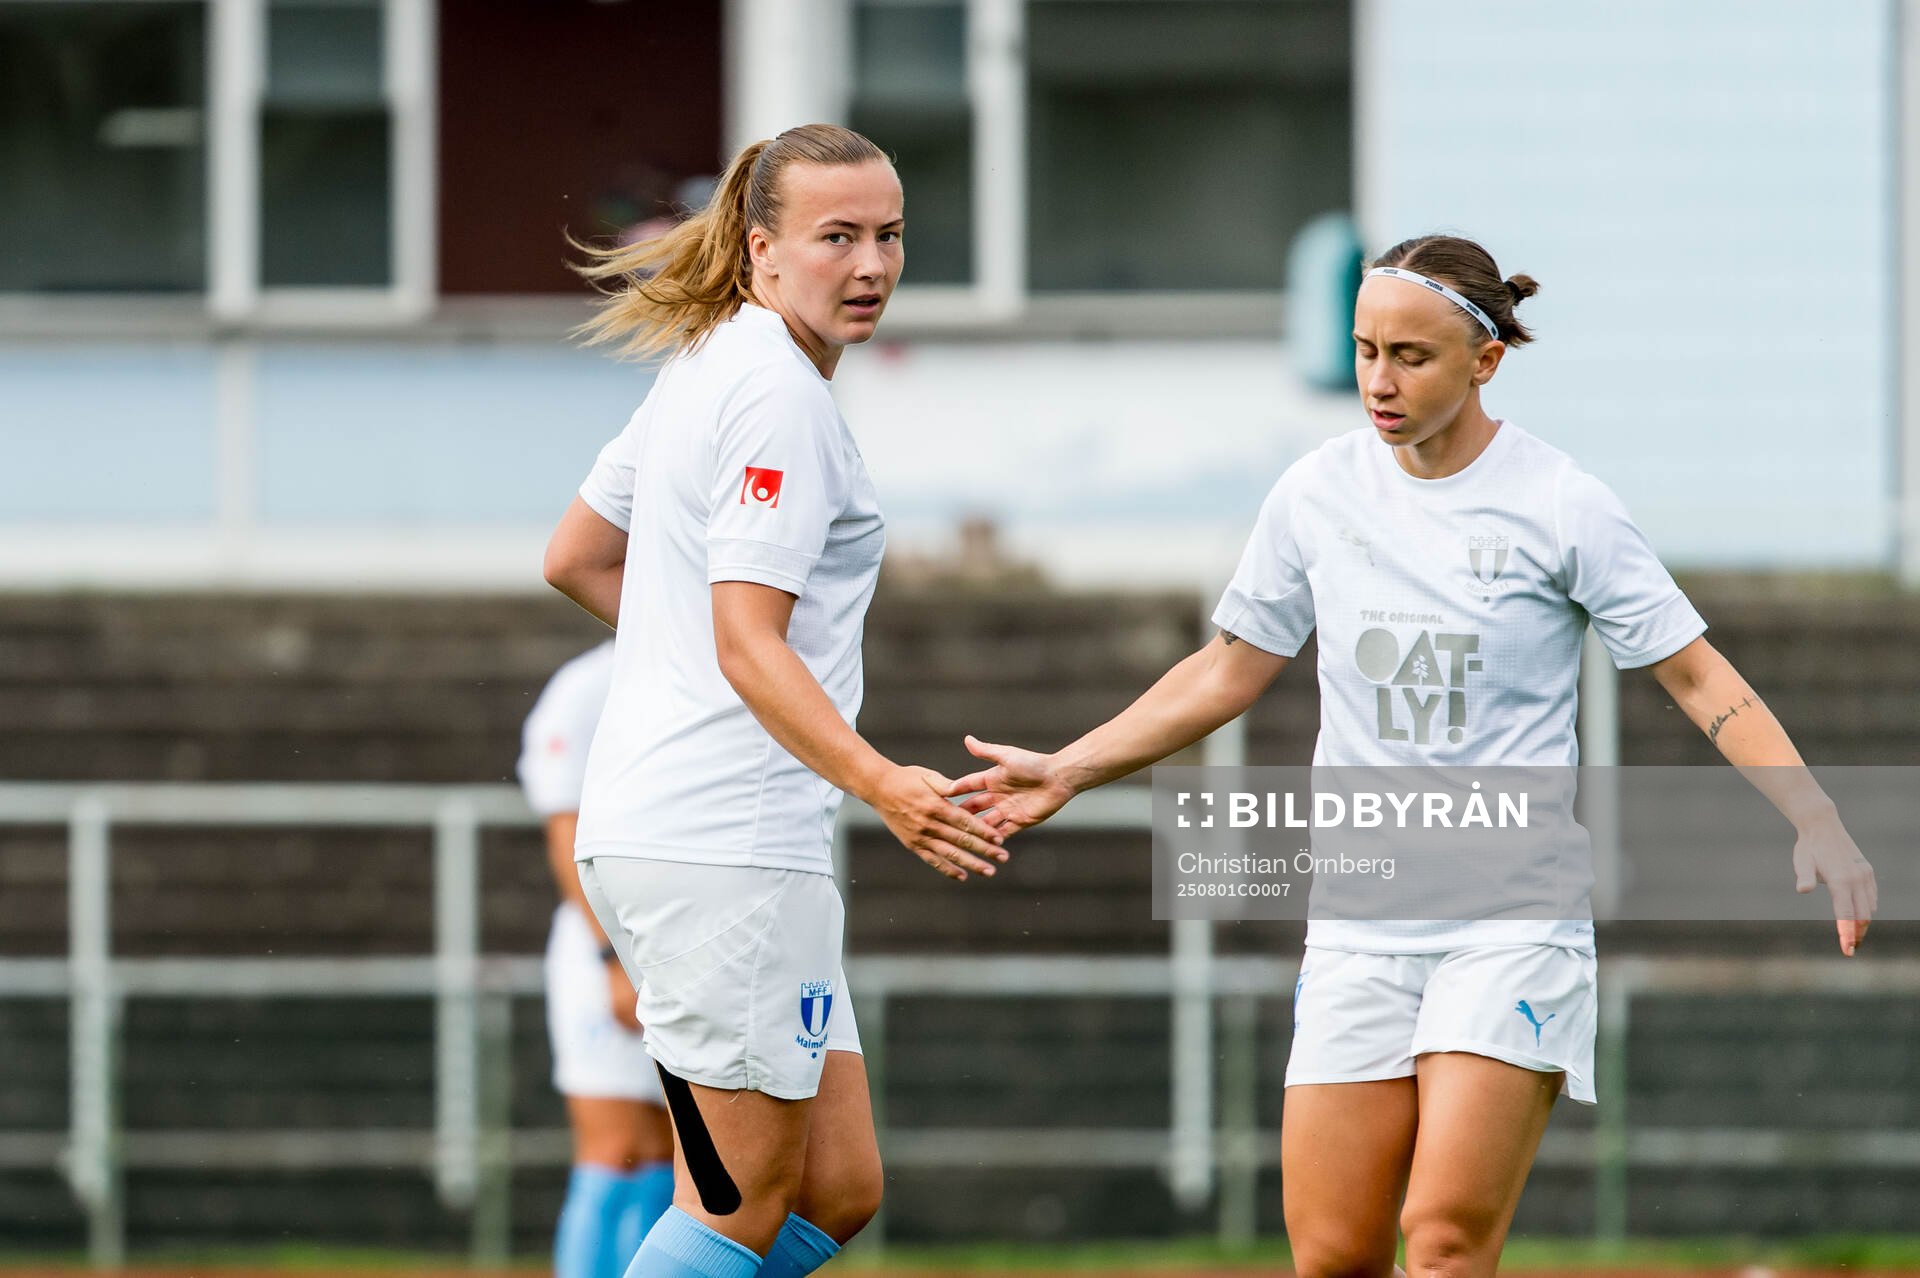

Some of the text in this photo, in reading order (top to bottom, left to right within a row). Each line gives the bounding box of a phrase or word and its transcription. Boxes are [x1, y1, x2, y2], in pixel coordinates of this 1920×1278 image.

[1359, 610, 1444, 625] THE ORIGINAL
[1376, 687, 1467, 745] LY!
